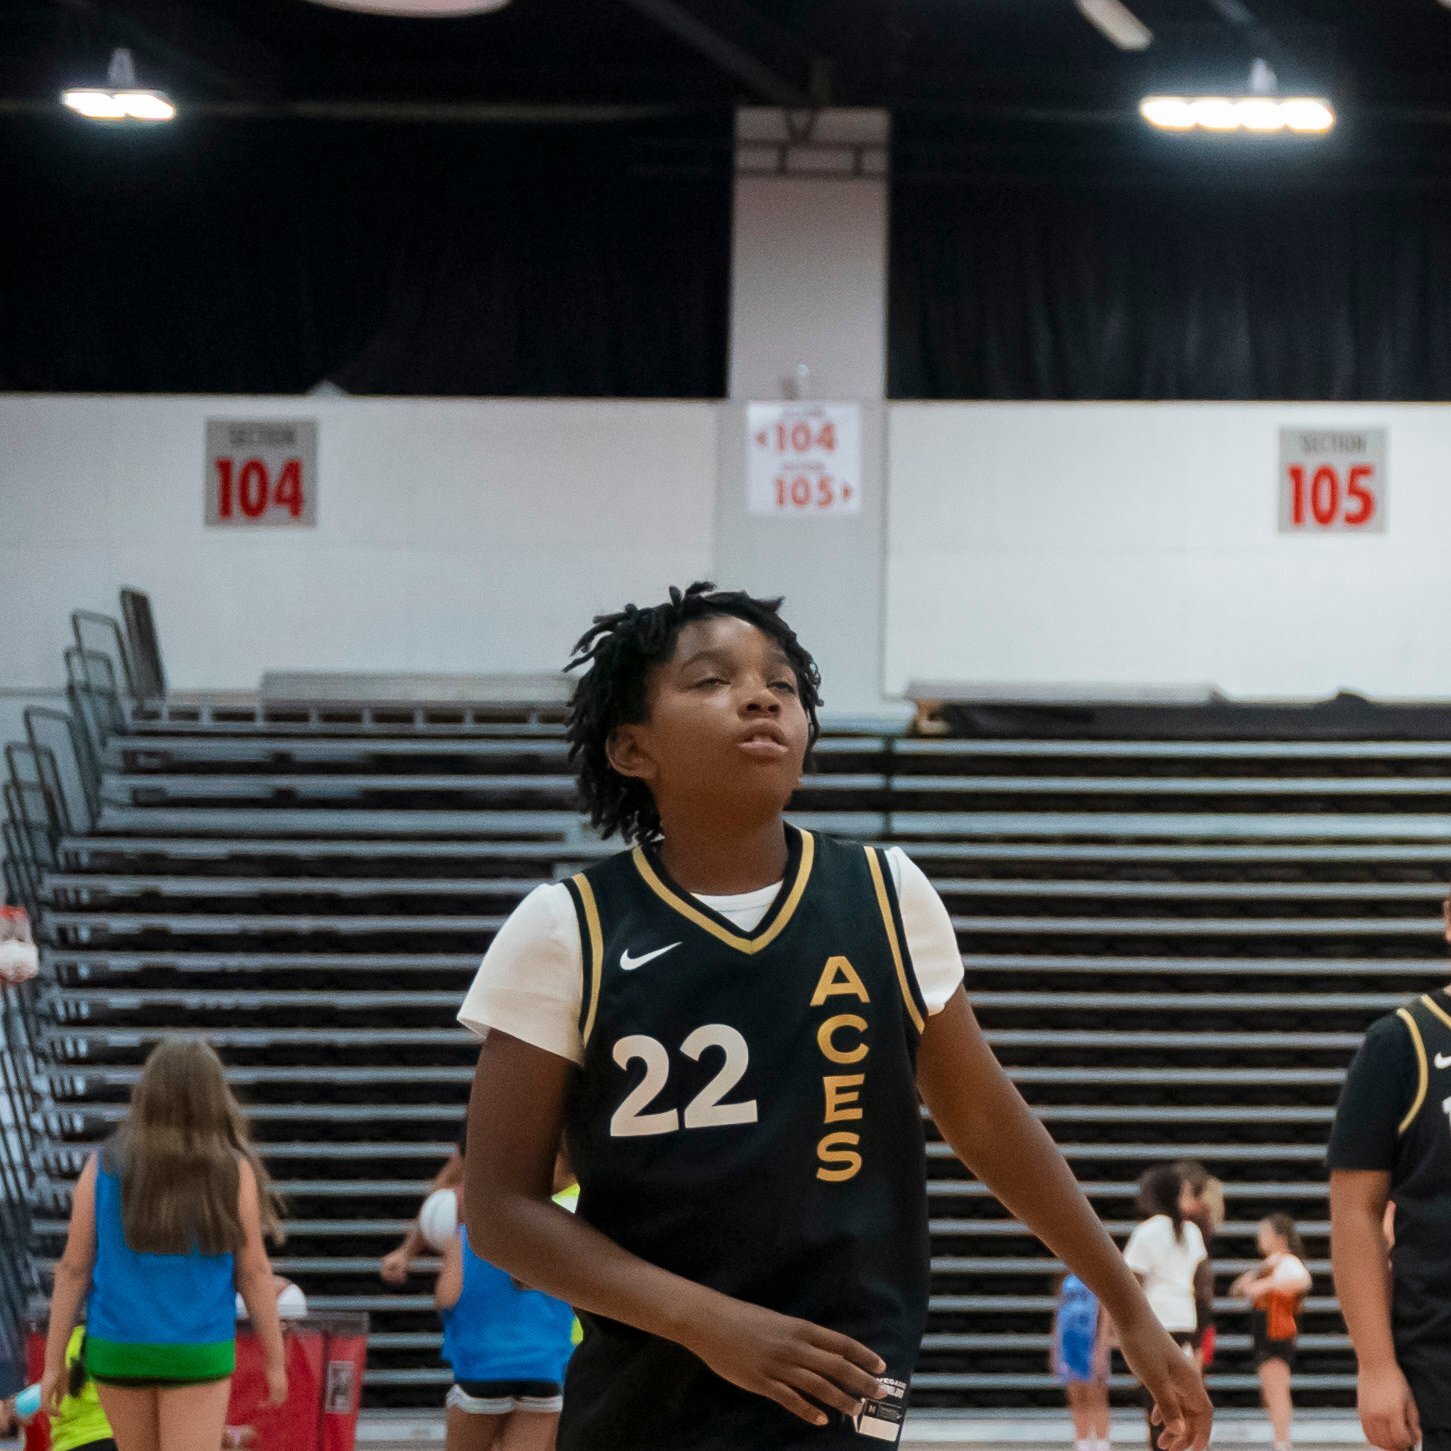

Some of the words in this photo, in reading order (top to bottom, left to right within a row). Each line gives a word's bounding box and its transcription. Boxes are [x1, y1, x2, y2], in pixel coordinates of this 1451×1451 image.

[773, 419, 838, 453] 104
[214, 455, 304, 520] 104
[774, 473, 836, 508] 105
[1286, 463, 1376, 526] 105
[609, 1023, 758, 1137] 22
[809, 955, 871, 1182] ACES
